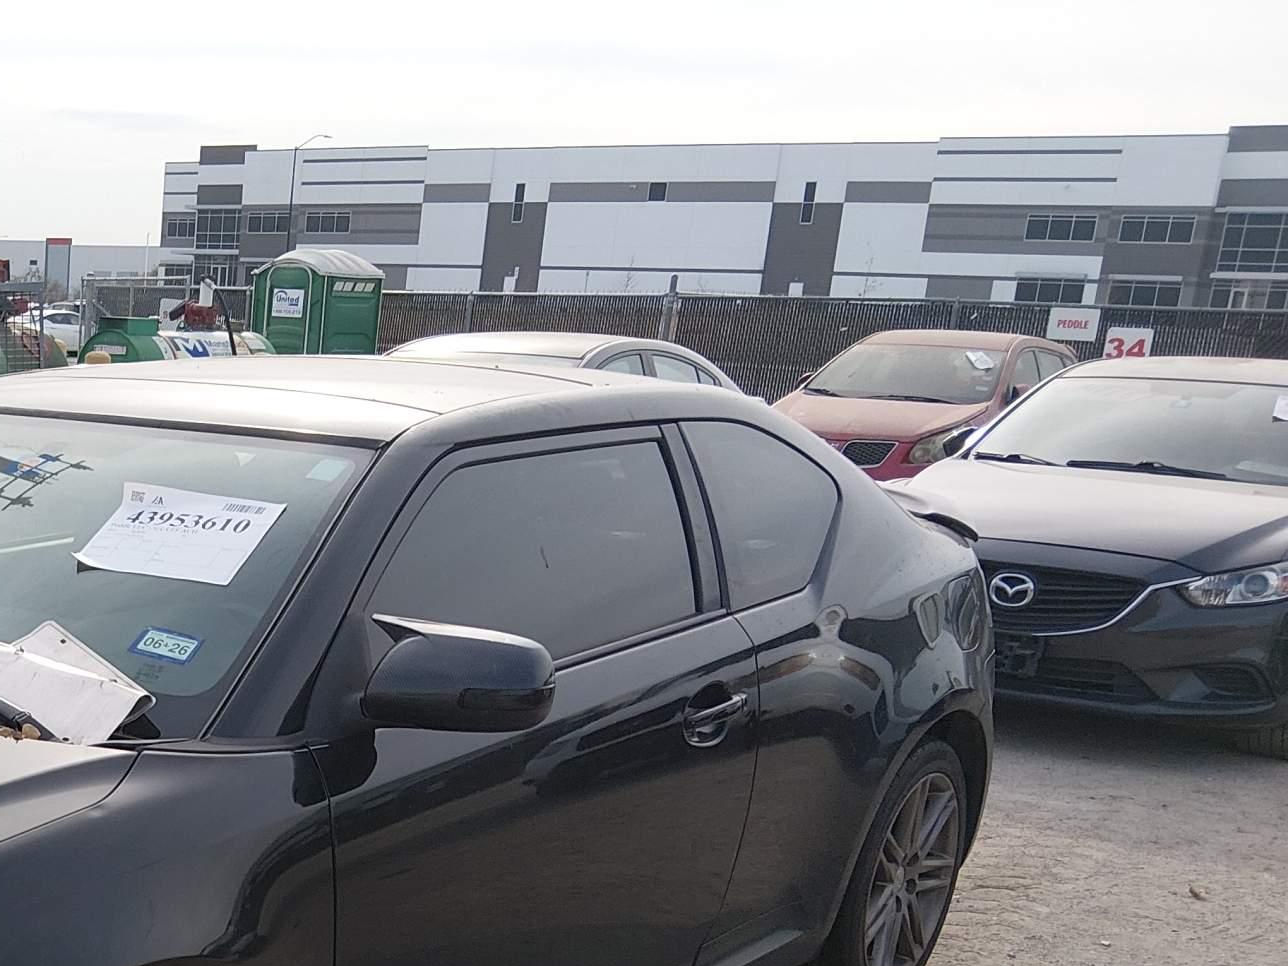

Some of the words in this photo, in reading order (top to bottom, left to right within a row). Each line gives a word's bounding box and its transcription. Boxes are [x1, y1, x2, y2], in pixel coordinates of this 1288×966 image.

[276, 294, 300, 304] United
[1056, 319, 1090, 330] PEDDLE
[1105, 337, 1147, 359] 34
[126, 510, 252, 534] 43953610
[143, 636, 165, 650] 06
[168, 642, 191, 656] 26
